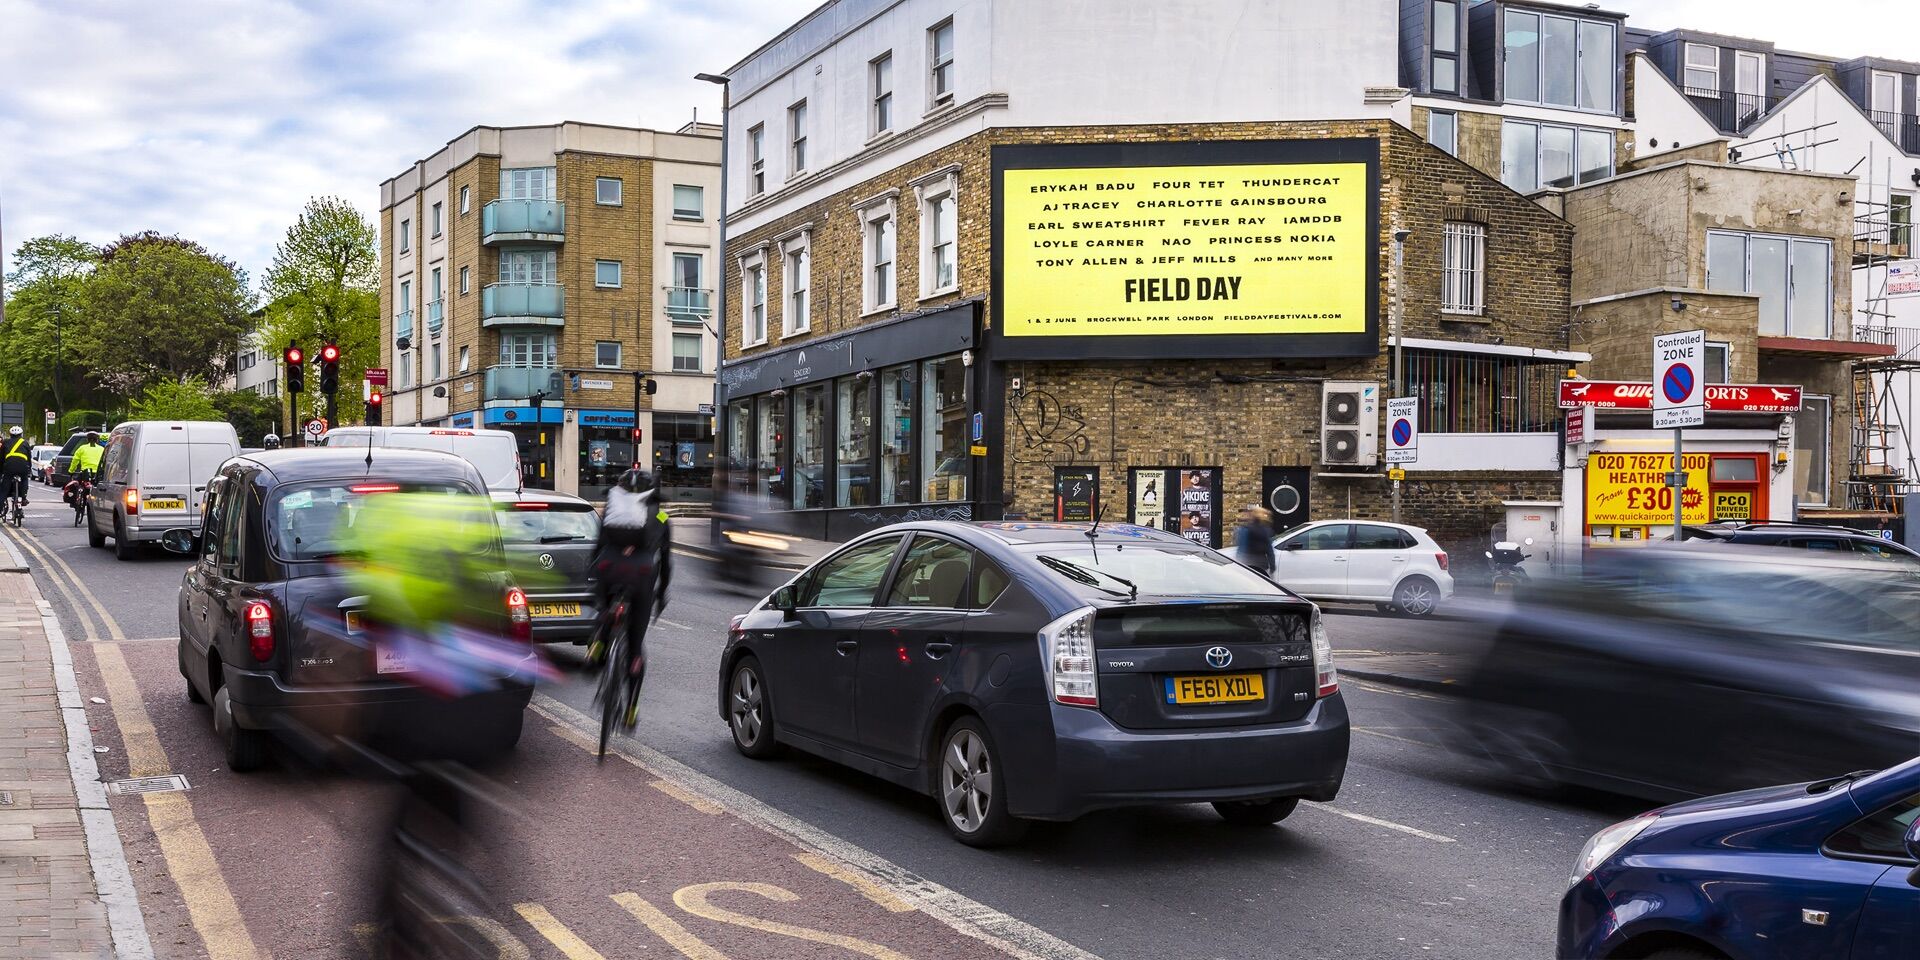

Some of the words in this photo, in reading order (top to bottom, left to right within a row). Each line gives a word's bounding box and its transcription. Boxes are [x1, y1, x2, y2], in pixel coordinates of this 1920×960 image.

[1030, 184, 1088, 194] ERYKAH
[1096, 183, 1136, 191] BADU
[1153, 181, 1191, 189] FOUR
[1242, 178, 1340, 187] THUNDERCAT
[1043, 203, 1058, 211] AJ
[1063, 202, 1120, 210] TRACEY
[1137, 200, 1223, 208] CHARLOTTE
[1231, 197, 1327, 206] GAINSBOURG
[1028, 222, 1064, 230] EARL
[1072, 219, 1166, 229] SWEATSHIRT
[1183, 218, 1230, 226] FEVER
[1238, 217, 1266, 225] RAY
[1284, 215, 1342, 224] IAMDDB
[1034, 240, 1078, 248] LOYLE
[1086, 239, 1144, 247] CARNER
[1162, 238, 1191, 246] NAO
[1209, 235, 1282, 245] PRINCESS
[1036, 258, 1074, 267] TONY
[1082, 257, 1128, 266] ALLEN
[1135, 257, 1144, 265] &
[1152, 256, 1185, 264] JEFF
[1193, 255, 1236, 263] MILLS
[1125, 278, 1190, 302] FIELD
[1196, 276, 1242, 301] DAY
[1224, 313, 1342, 321] FIELDDAYFESTIVALS.COM
[1657, 334, 1701, 348] Controlled
[1663, 347, 1694, 361] ZONE
[1389, 400, 1416, 408] Controlled
[1392, 408, 1412, 417] ZONE
[1598, 455, 1625, 470] 020
[1630, 455, 1664, 469] 7627
[1595, 488, 1624, 508] From
[1627, 486, 1672, 511] £30
[1682, 492, 1699, 503] 24/7
[1718, 495, 1747, 506] PCO
[555, 604, 577, 614] YNN
[1181, 678, 1221, 699] FE61
[1226, 677, 1257, 697] XDL
